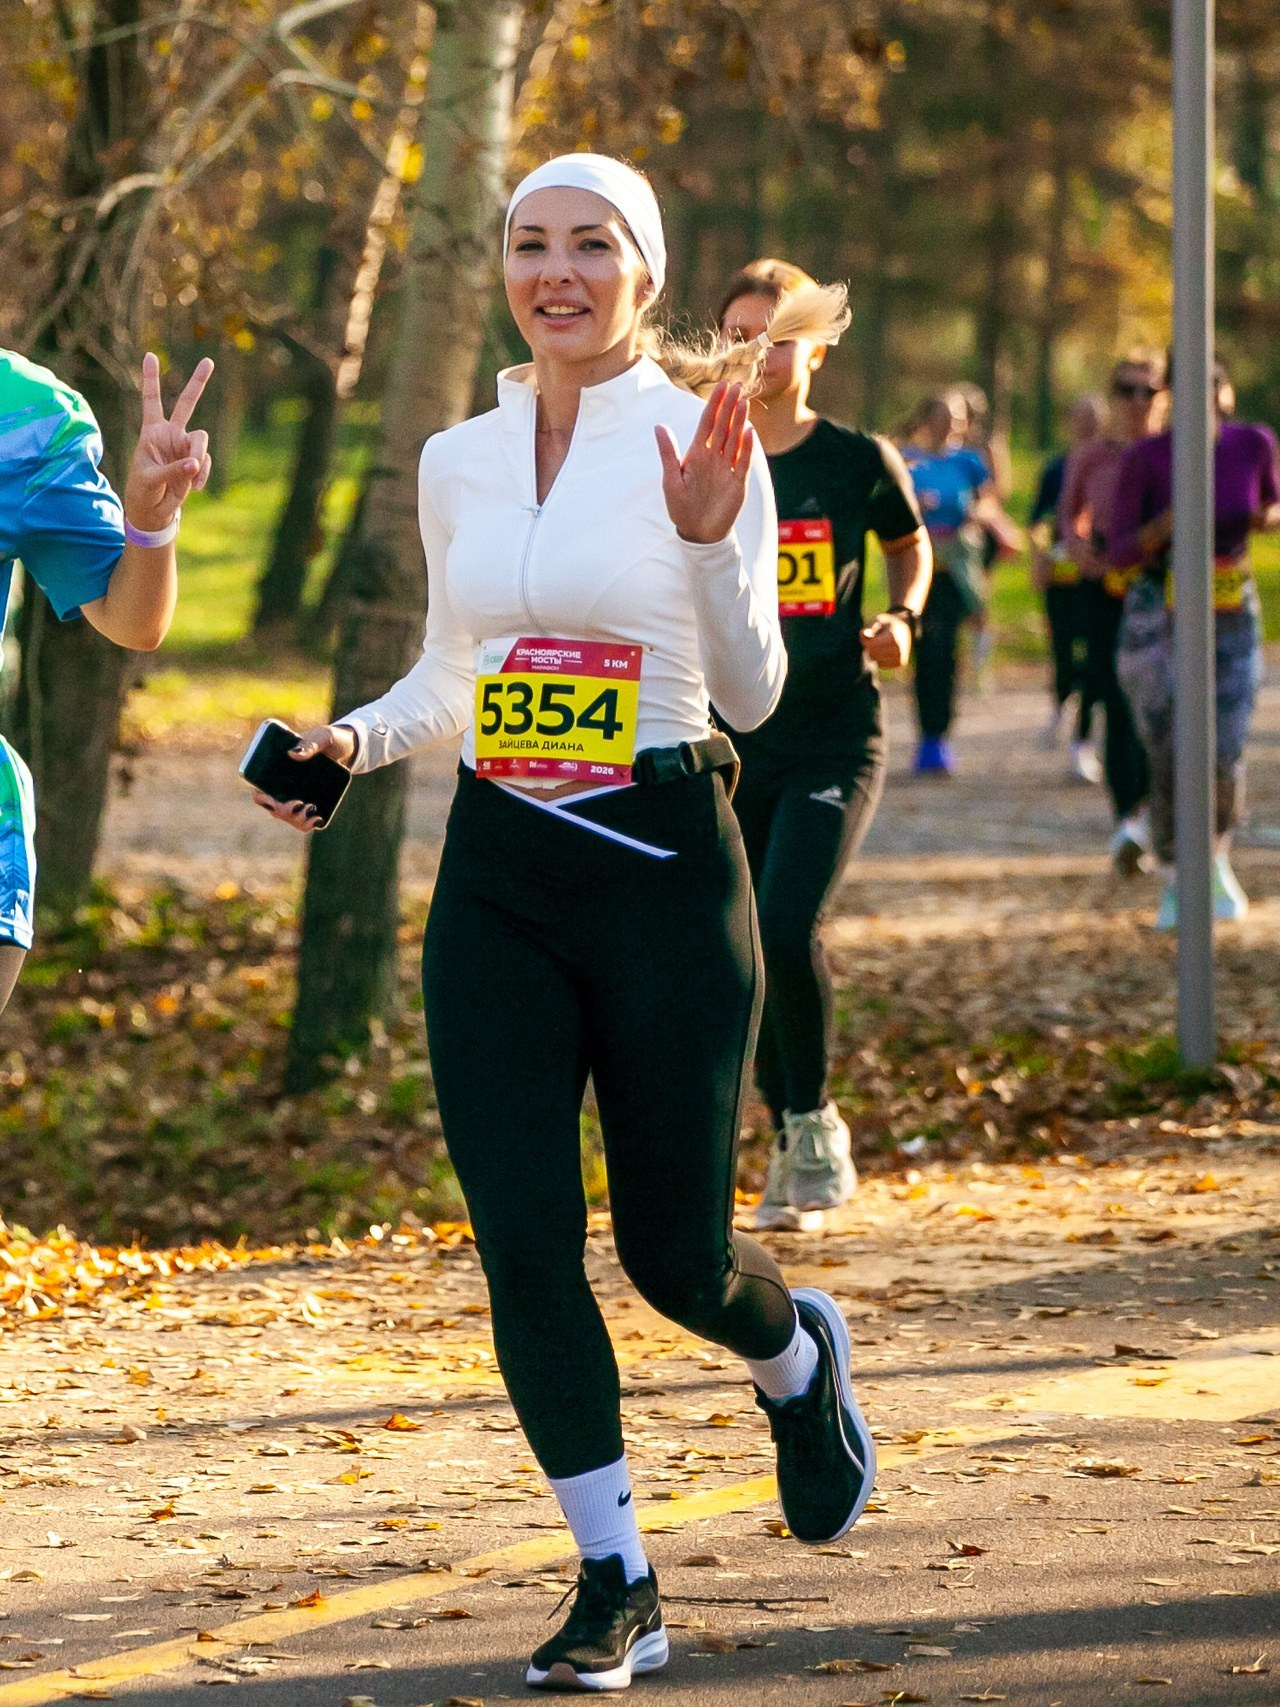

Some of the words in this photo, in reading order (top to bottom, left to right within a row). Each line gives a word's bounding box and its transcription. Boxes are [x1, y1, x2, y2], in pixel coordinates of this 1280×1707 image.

[516, 648, 582, 659] КРАСНОЯРСКИЕ
[531, 656, 562, 665] МОСТЫ
[604, 659, 610, 667] 5
[611, 660, 628, 669] КМ
[481, 681, 623, 740] 5354
[498, 737, 539, 750] ЗАЙЦЕВА
[541, 740, 584, 752] ДИАНА
[590, 765, 614, 775] 2026
